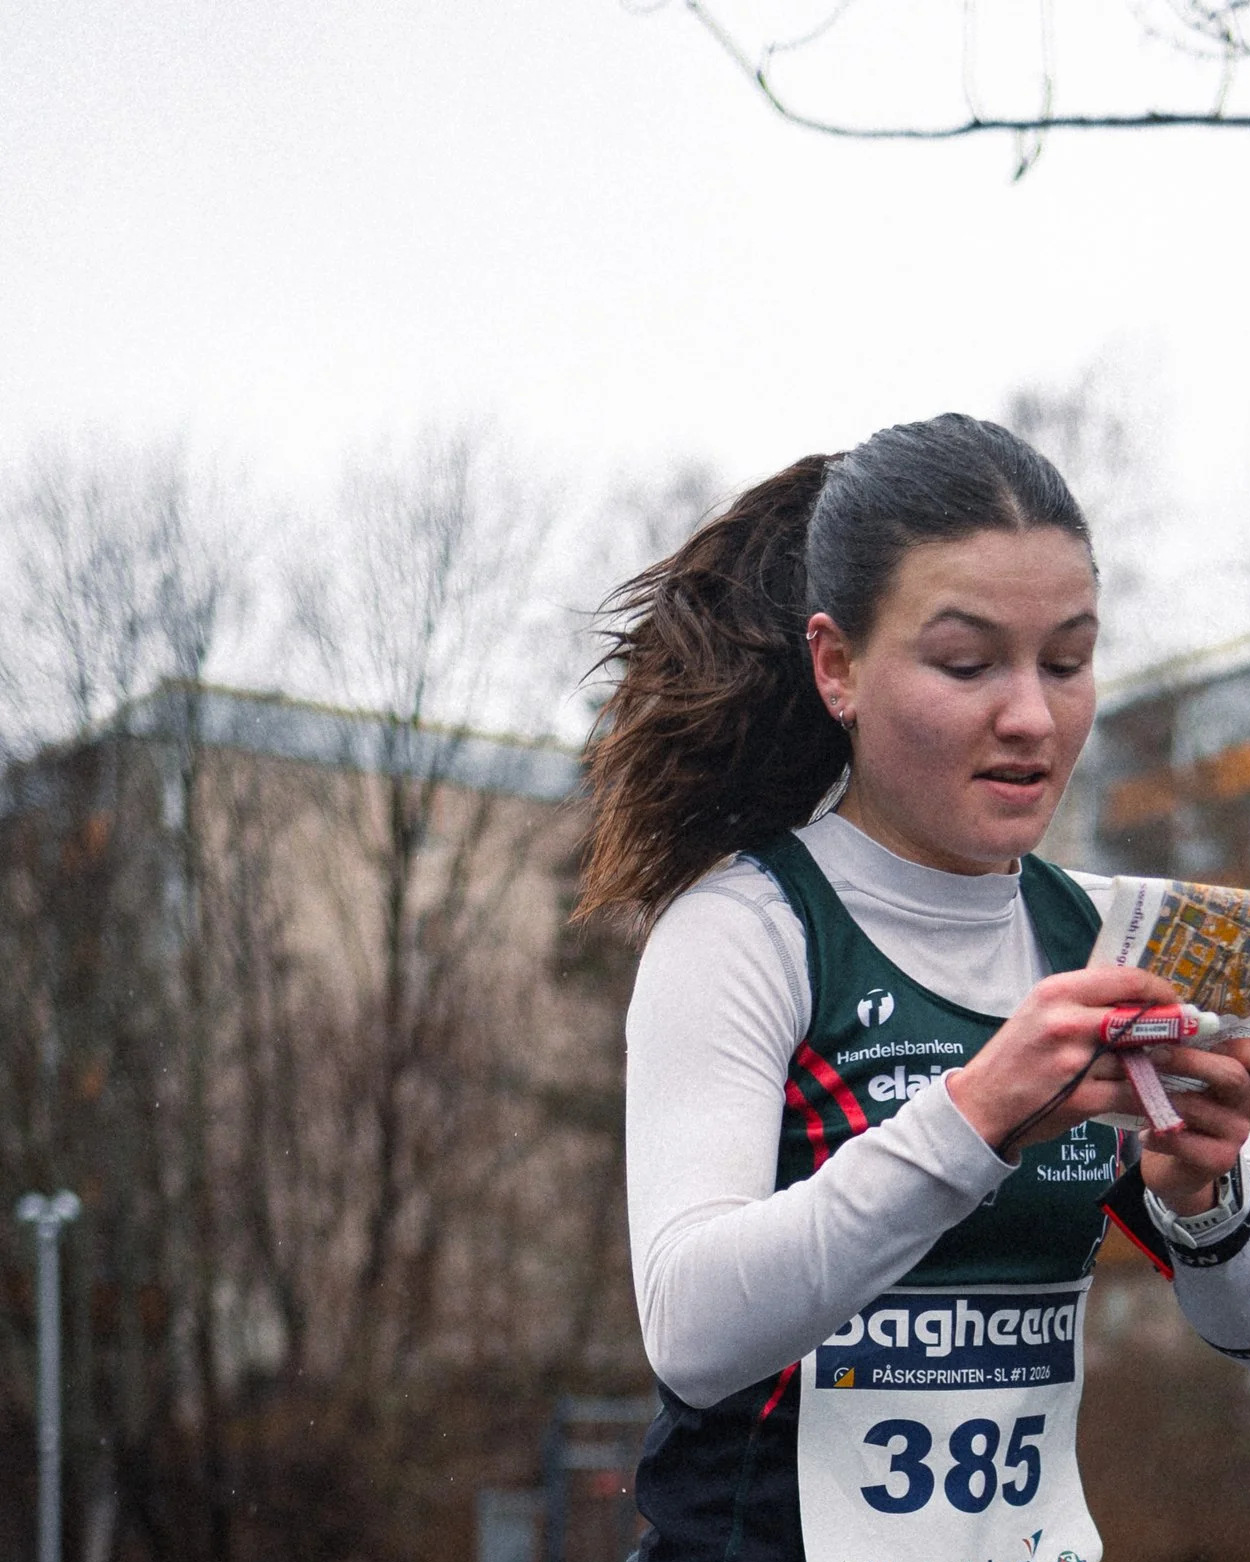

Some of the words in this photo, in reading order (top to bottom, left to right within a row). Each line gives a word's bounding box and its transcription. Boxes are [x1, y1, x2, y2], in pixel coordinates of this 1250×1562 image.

[837, 1039, 964, 1065] Handelsbanken
[1061, 1144, 1097, 1165] Eksjö
[1036, 1163, 1110, 1182] Stadshotell
[872, 1364, 985, 1384] PÅSKSPRINTEN
[994, 1368, 1009, 1382] SL
[1010, 1366, 1027, 1382] #1
[1030, 1365, 1051, 1381] 2026
[860, 1413, 1047, 1515] 385
